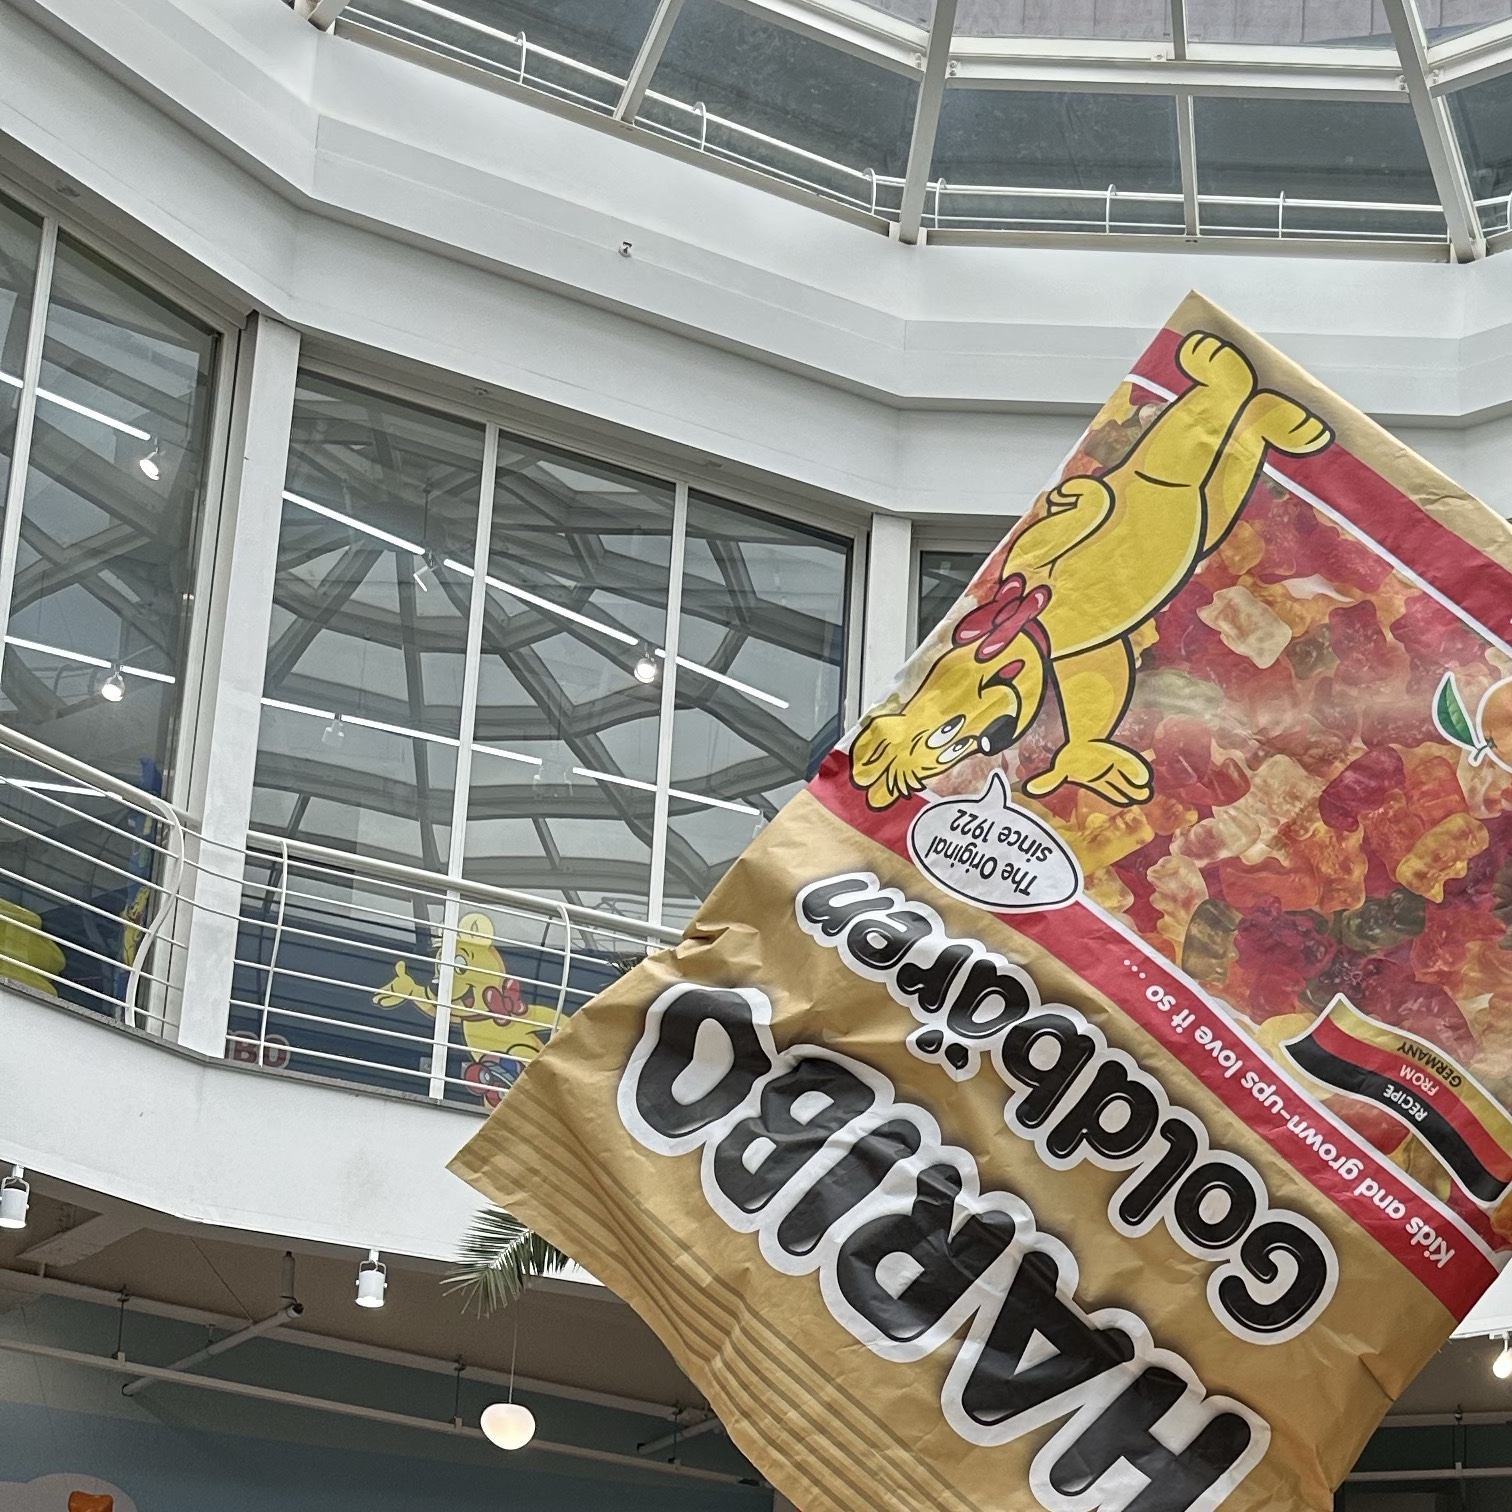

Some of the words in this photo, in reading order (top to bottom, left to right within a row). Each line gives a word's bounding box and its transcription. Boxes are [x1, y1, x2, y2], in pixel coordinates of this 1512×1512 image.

[950, 808, 995, 843] 1922
[997, 826, 1053, 863] since
[924, 835, 998, 880] Original
[1001, 863, 1038, 896] The
[1145, 984, 1177, 1012] so
[1171, 1008, 1196, 1033] it
[1194, 1025, 1243, 1078] love
[1396, 1041, 1462, 1088] GERMANY
[1400, 1064, 1440, 1096] FROM
[799, 872, 1333, 1337] Goldbären
[1383, 1084, 1428, 1122] RECIPE
[1241, 1071, 1365, 1180] grown-ups
[1353, 1180, 1406, 1221] and
[1405, 1216, 1456, 1268] Kids
